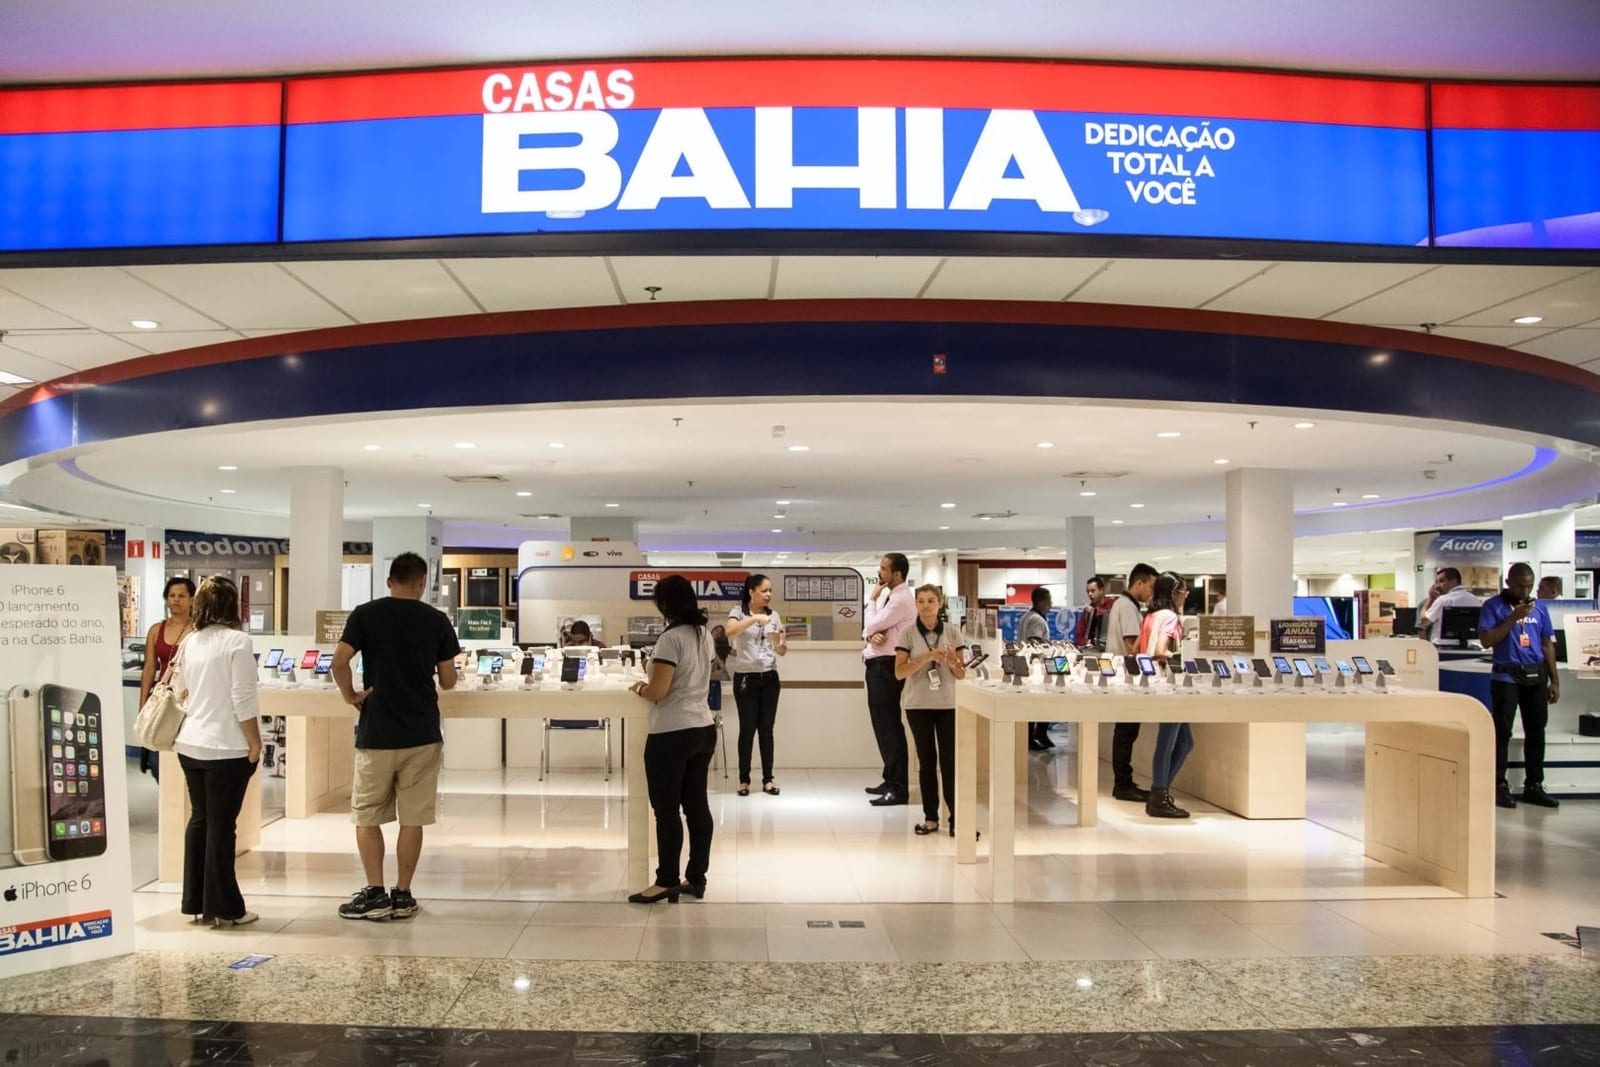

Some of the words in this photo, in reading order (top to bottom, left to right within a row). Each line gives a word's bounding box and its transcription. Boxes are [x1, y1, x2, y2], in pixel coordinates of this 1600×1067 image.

[482, 69, 635, 113] CASAS
[1084, 121, 1236, 152] DEDICAÇÃO
[481, 106, 1082, 213] BAHIA
[1106, 151, 1191, 177] TOTAL
[1194, 154, 1216, 178] A
[1125, 177, 1197, 205] VOCÊ
[606, 549, 623, 557] vivo
[1439, 539, 1495, 551] Audio
[11, 584, 55, 596] iPhone
[56, 584, 65, 596] 6
[8, 601, 80, 613] lançamento
[1, 618, 59, 630] esperado
[61, 618, 78, 629] do
[80, 619, 105, 629] ano,
[12, 636, 28, 646] na
[31, 633, 66, 645] Casas
[69, 633, 105, 645] Bahia.
[21, 880, 78, 900] iPhone
[81, 873, 92, 890] 6
